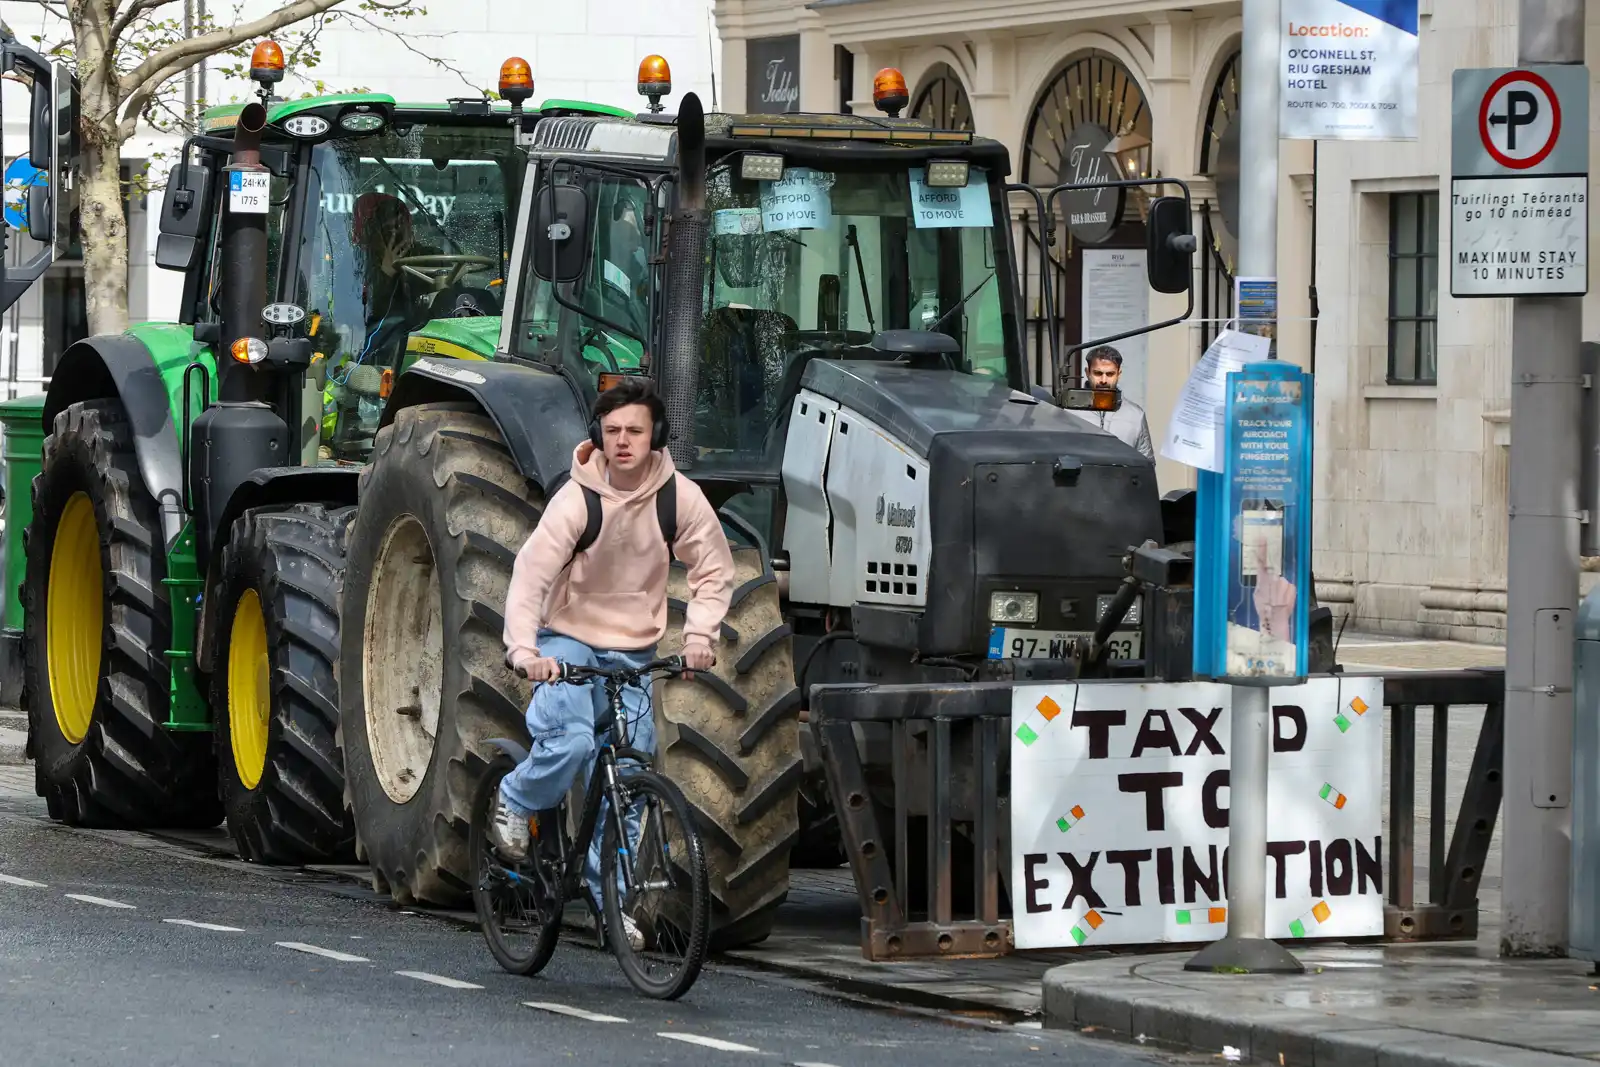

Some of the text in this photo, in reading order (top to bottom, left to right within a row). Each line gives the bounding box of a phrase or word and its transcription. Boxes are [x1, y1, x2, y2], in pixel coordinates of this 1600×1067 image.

[1289, 22, 1369, 37] Location:
[1288, 48, 1377, 62] O'CONNELL ST,
[1288, 64, 1372, 75] RIU GRESHAM
[761, 56, 798, 112] Teddys
[1288, 79, 1328, 89] HOTEL
[1287, 101, 1313, 109] ROUTE
[1371, 102, 1377, 110] &
[1507, 90, 1539, 150] P
[1066, 142, 1109, 207] Teddys
[241, 195, 259, 206] 1775
[919, 193, 958, 203] AFFORD
[1452, 192, 1585, 207] Tuirlingt Teóranta
[769, 212, 784, 222] TO
[787, 210, 816, 221] MOVE
[920, 210, 965, 220] TO MOVE
[1465, 206, 1572, 222] go 10 nóiméad
[1458, 250, 1577, 264] MAXIMUM STAY
[1472, 266, 1565, 280] 10 MINUTES
[1238, 419, 1293, 428] TRACK YOUR
[1242, 431, 1288, 439] AIRCOACH
[1240, 442, 1289, 450] WITH YOUR
[1239, 453, 1289, 461] FINGERTIPS
[1071, 704, 1308, 760] TAXD
[1024, 835, 1383, 914] EXTINTION
